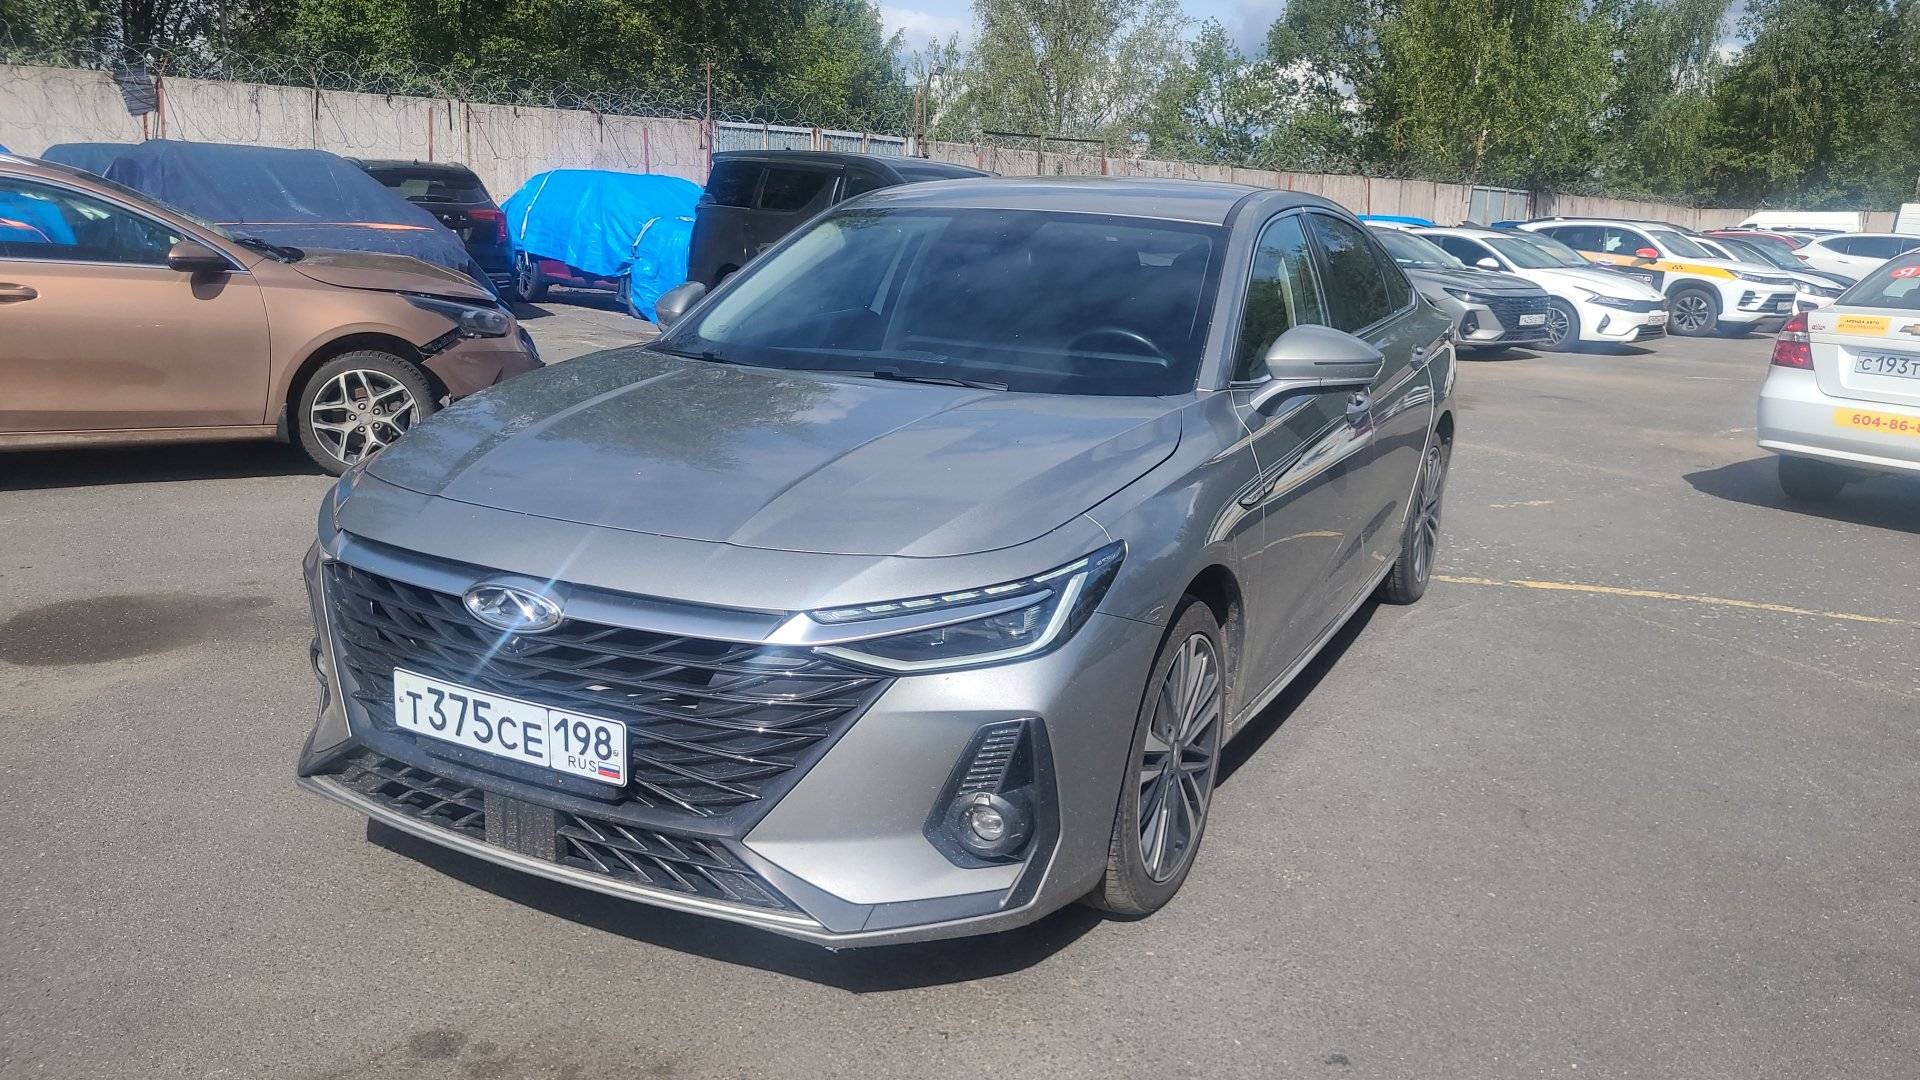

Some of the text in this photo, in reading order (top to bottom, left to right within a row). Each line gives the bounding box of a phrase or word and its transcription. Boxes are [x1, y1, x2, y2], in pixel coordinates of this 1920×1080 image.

[406, 686, 613, 761] Т375СЕ 198
[567, 755, 597, 773] RUS
